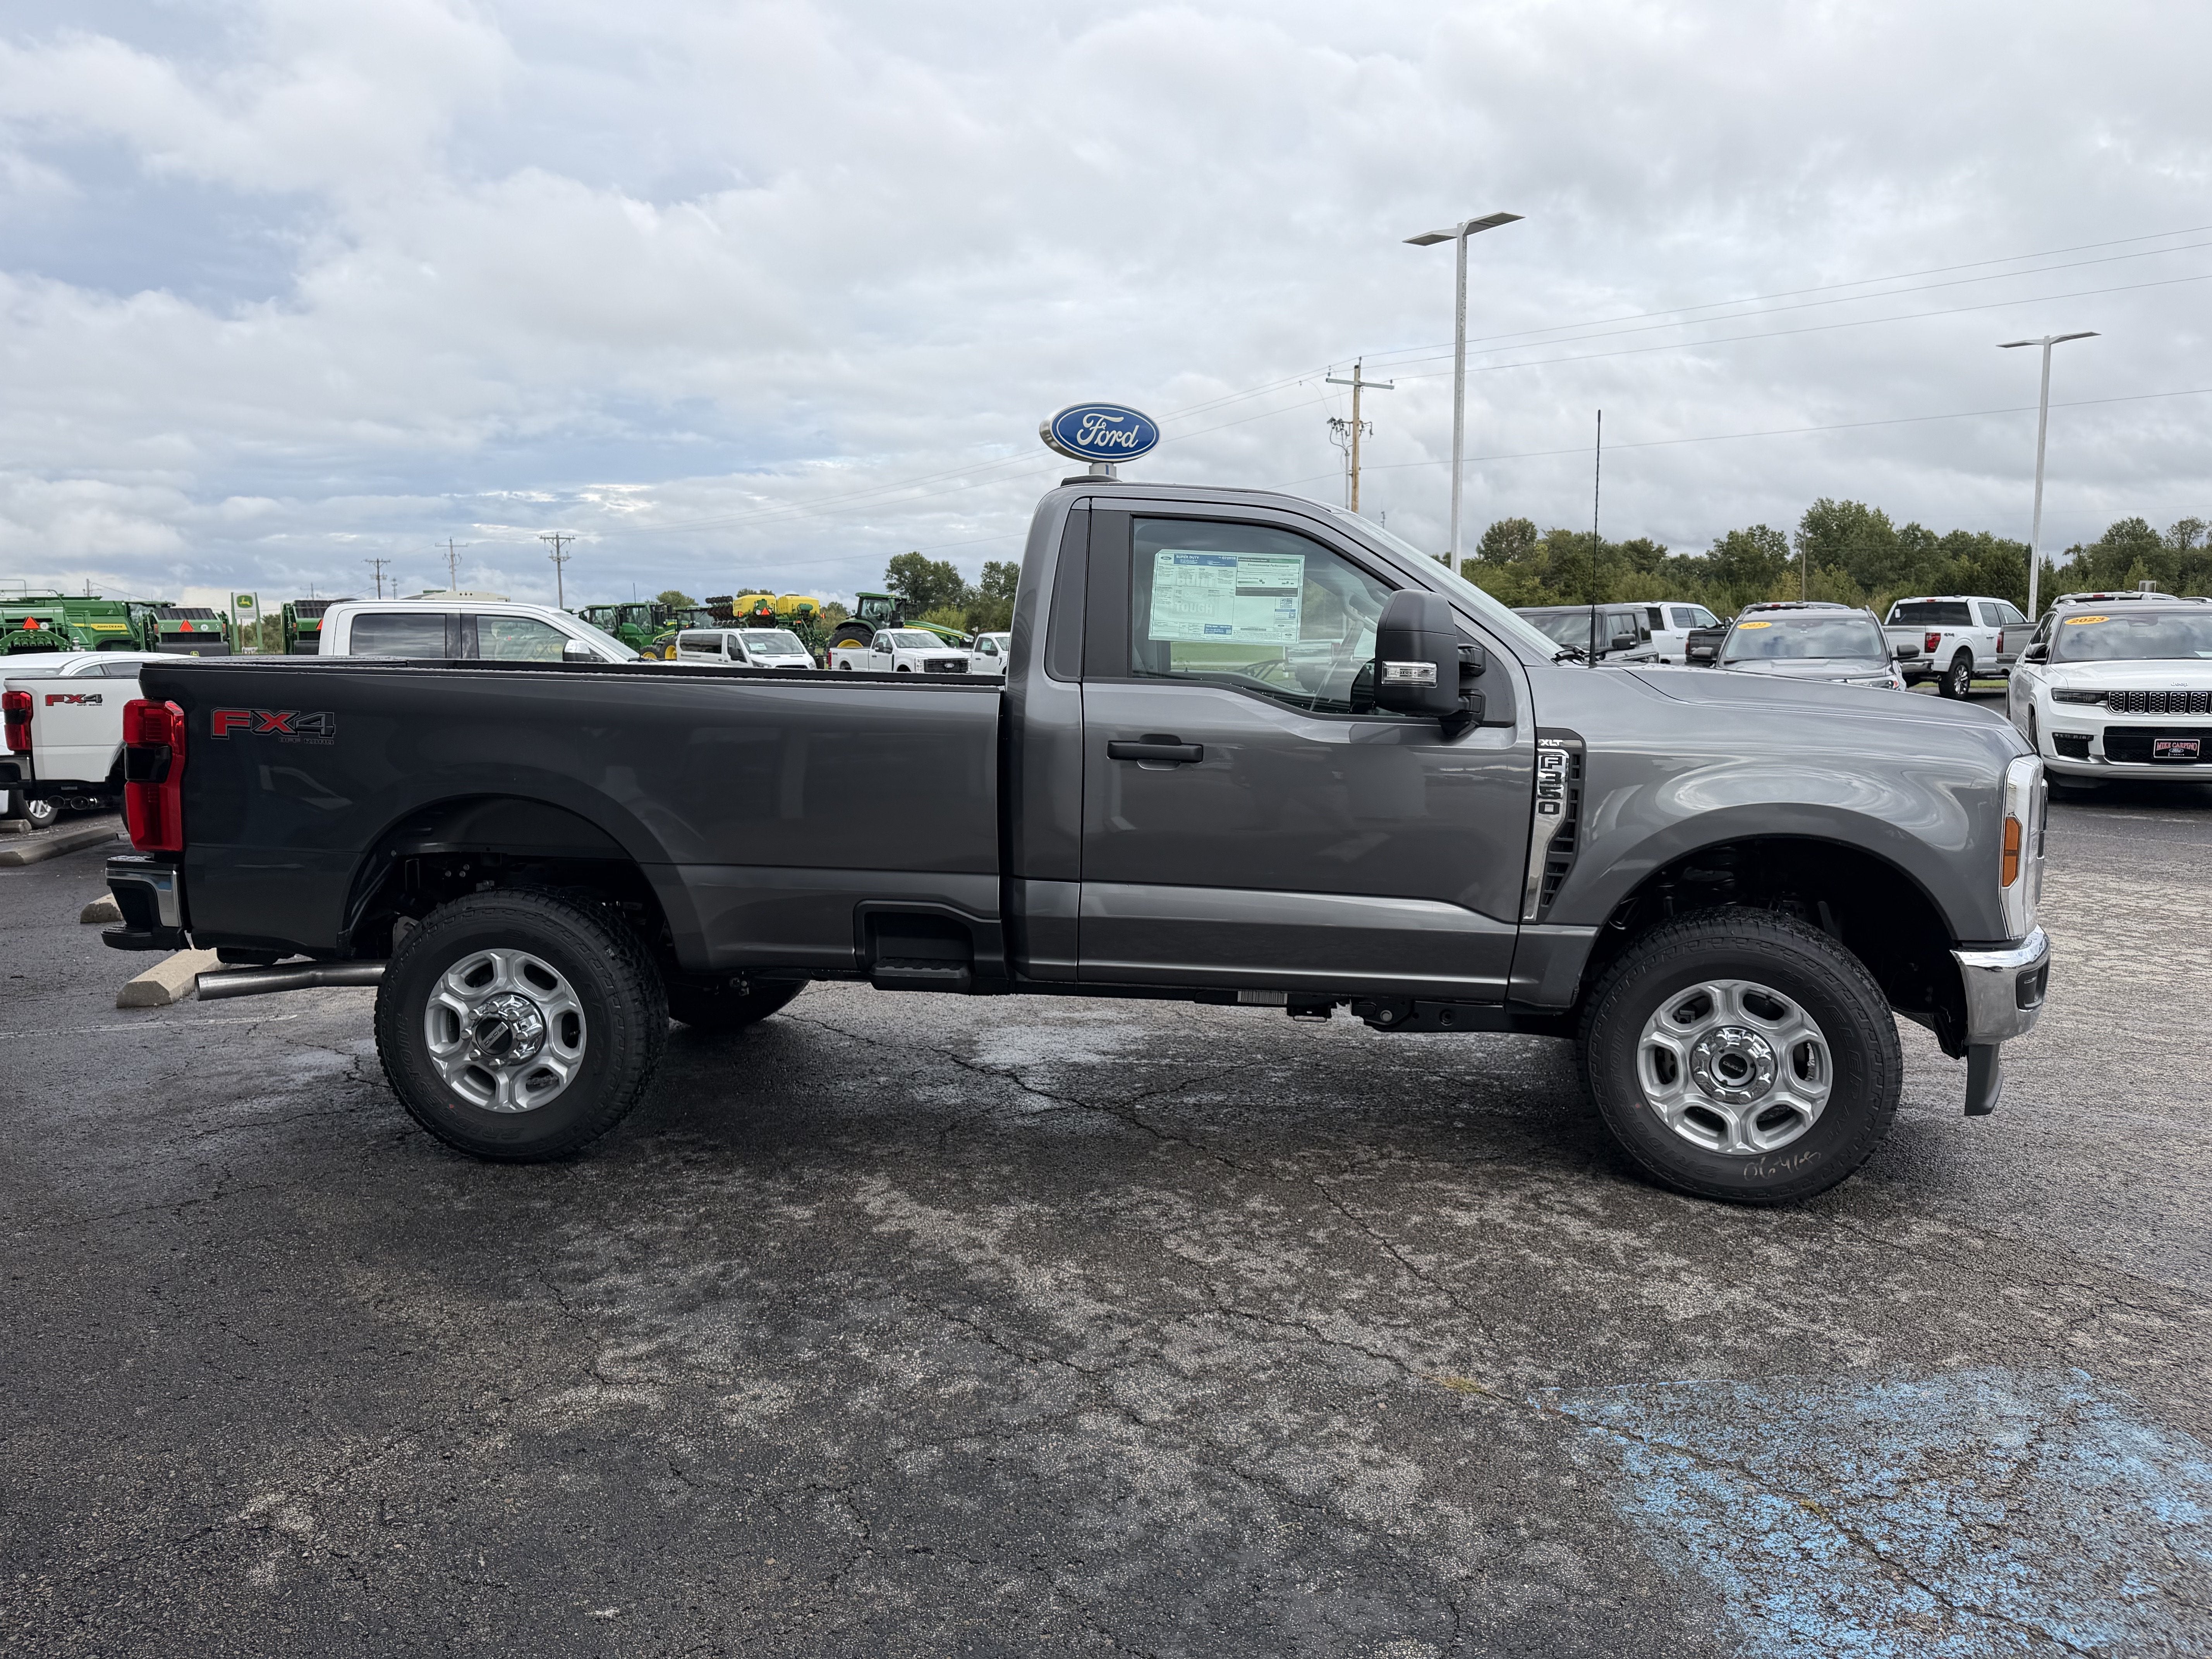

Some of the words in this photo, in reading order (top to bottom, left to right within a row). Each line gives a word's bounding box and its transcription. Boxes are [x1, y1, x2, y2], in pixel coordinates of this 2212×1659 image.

[1077, 413, 1139, 448] Ford
[1175, 602, 1213, 614] TOUGH
[45, 694, 103, 706] FX4
[211, 707, 336, 740] FX4
[2156, 742, 2171, 751] MIKE
[2172, 742, 2197, 751] CARPINO
[484, 1026, 503, 1046] FORD
